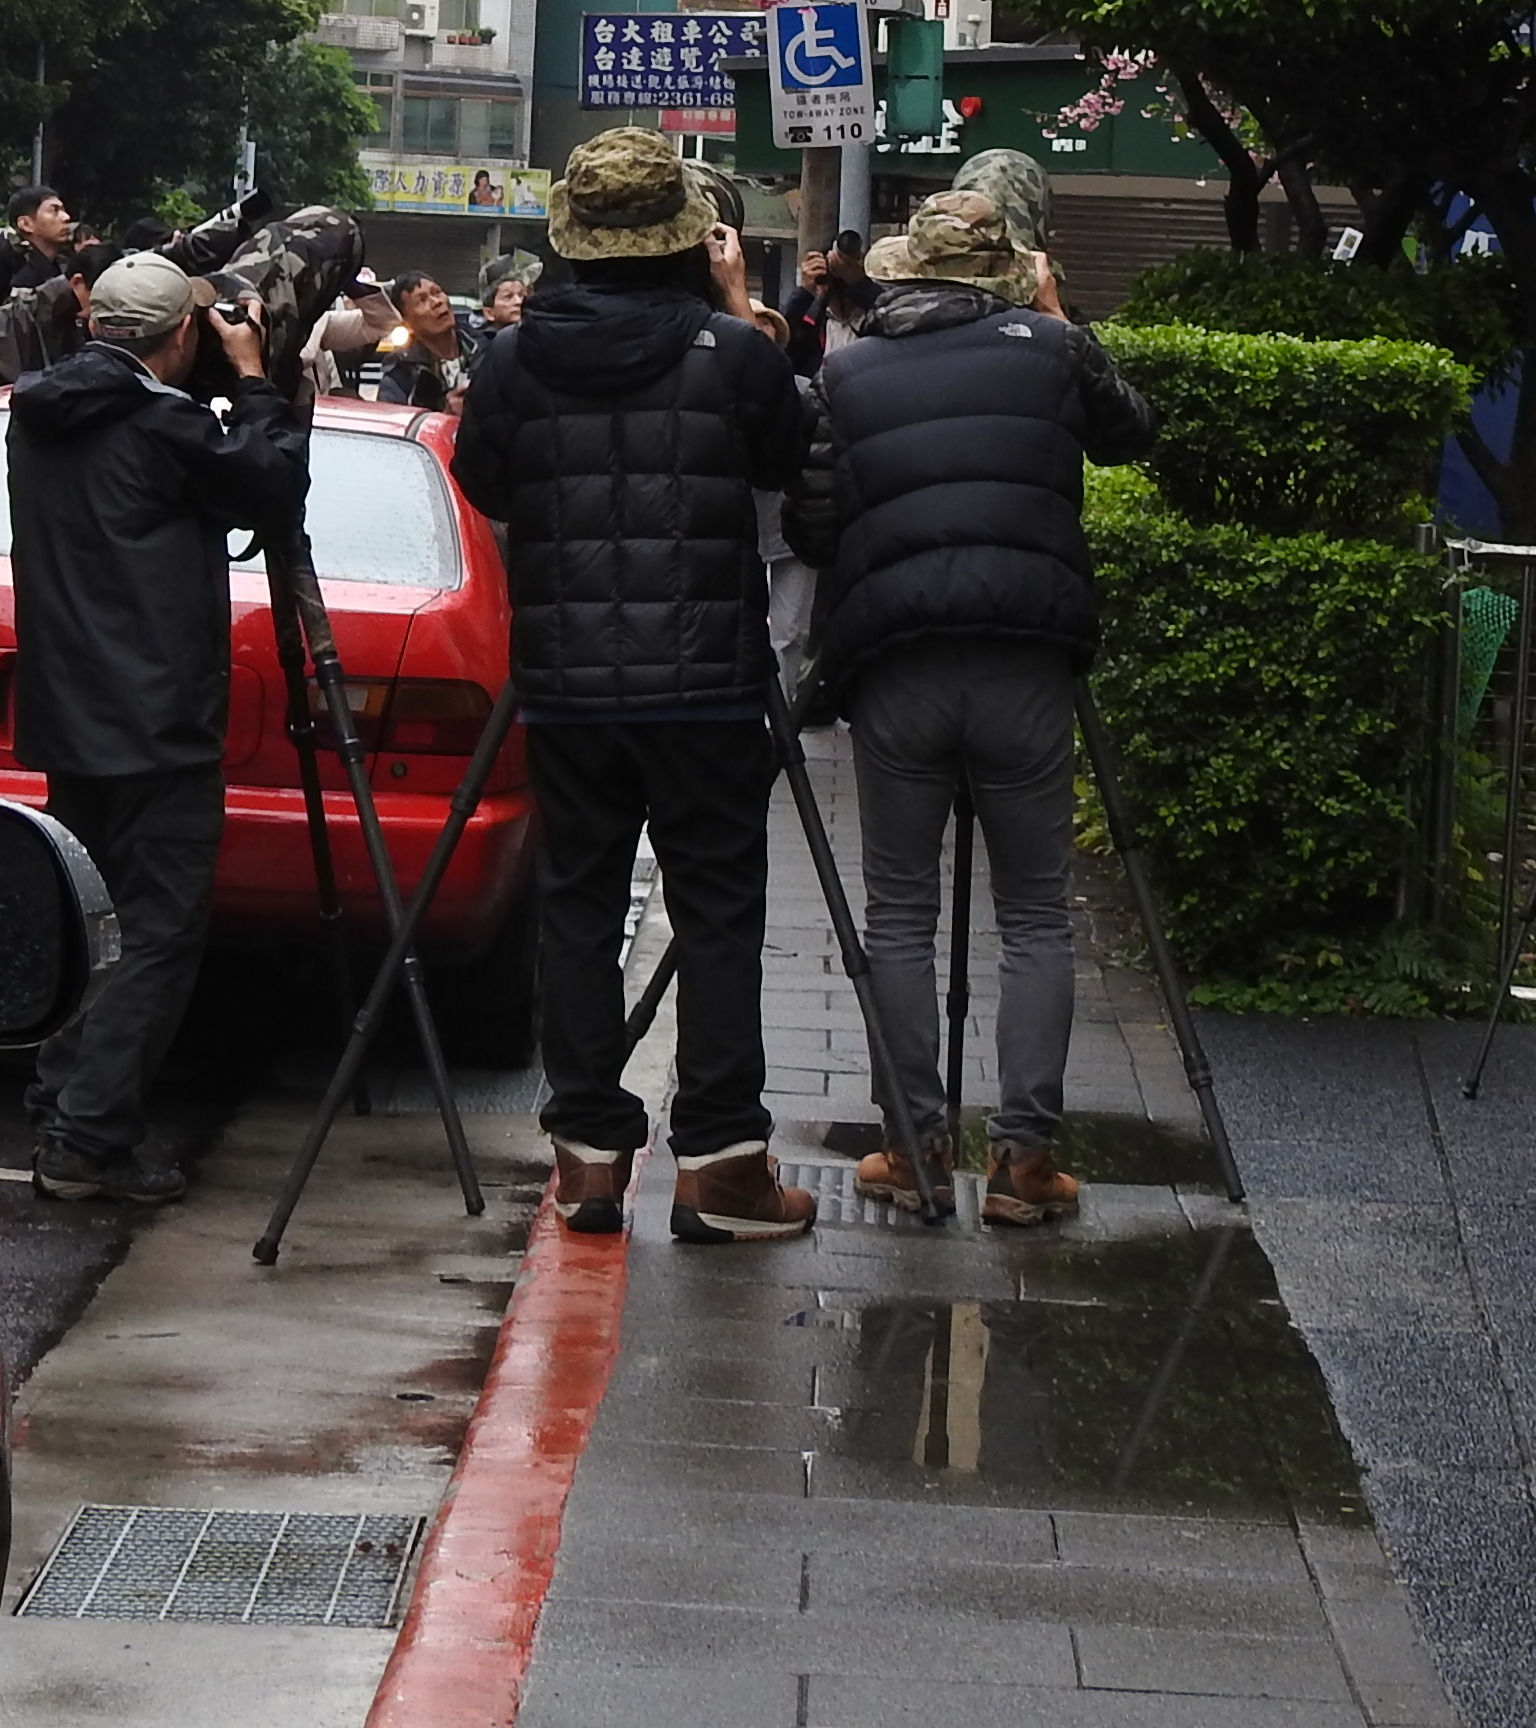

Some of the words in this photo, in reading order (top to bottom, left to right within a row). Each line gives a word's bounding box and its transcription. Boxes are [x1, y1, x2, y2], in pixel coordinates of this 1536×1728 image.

[594, 19, 761, 45] 台大租車公司
[783, 108, 835, 119] TOW-AWAY
[839, 105, 865, 117] ZONE
[822, 123, 863, 141] 110
[365, 168, 465, 198] 際人力資源
